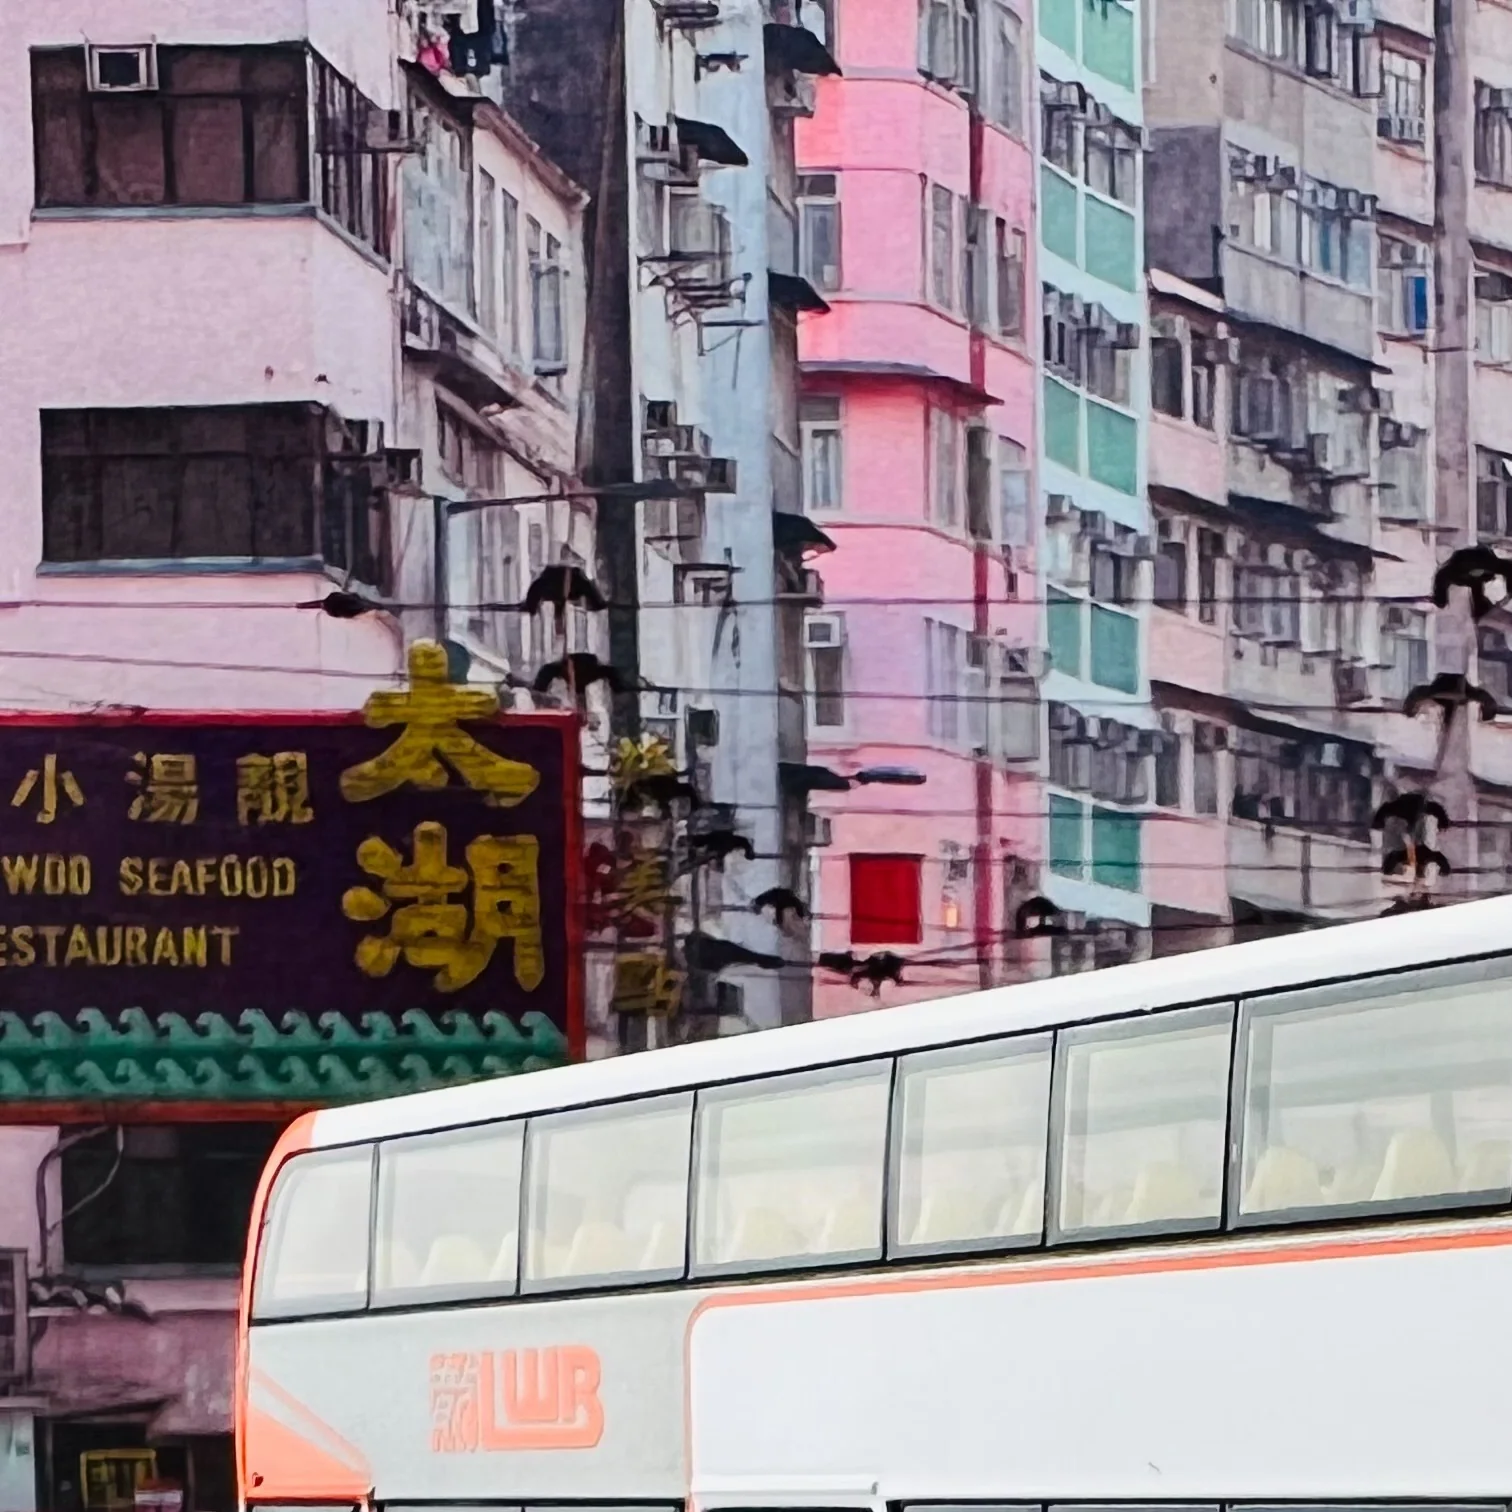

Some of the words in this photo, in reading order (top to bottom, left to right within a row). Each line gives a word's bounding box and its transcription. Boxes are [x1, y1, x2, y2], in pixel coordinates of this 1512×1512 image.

[340, 638, 543, 992] 太湖
[2, 854, 91, 896] WOO
[119, 853, 297, 899] SEAFOOD
[479, 1344, 605, 1449] LWB
